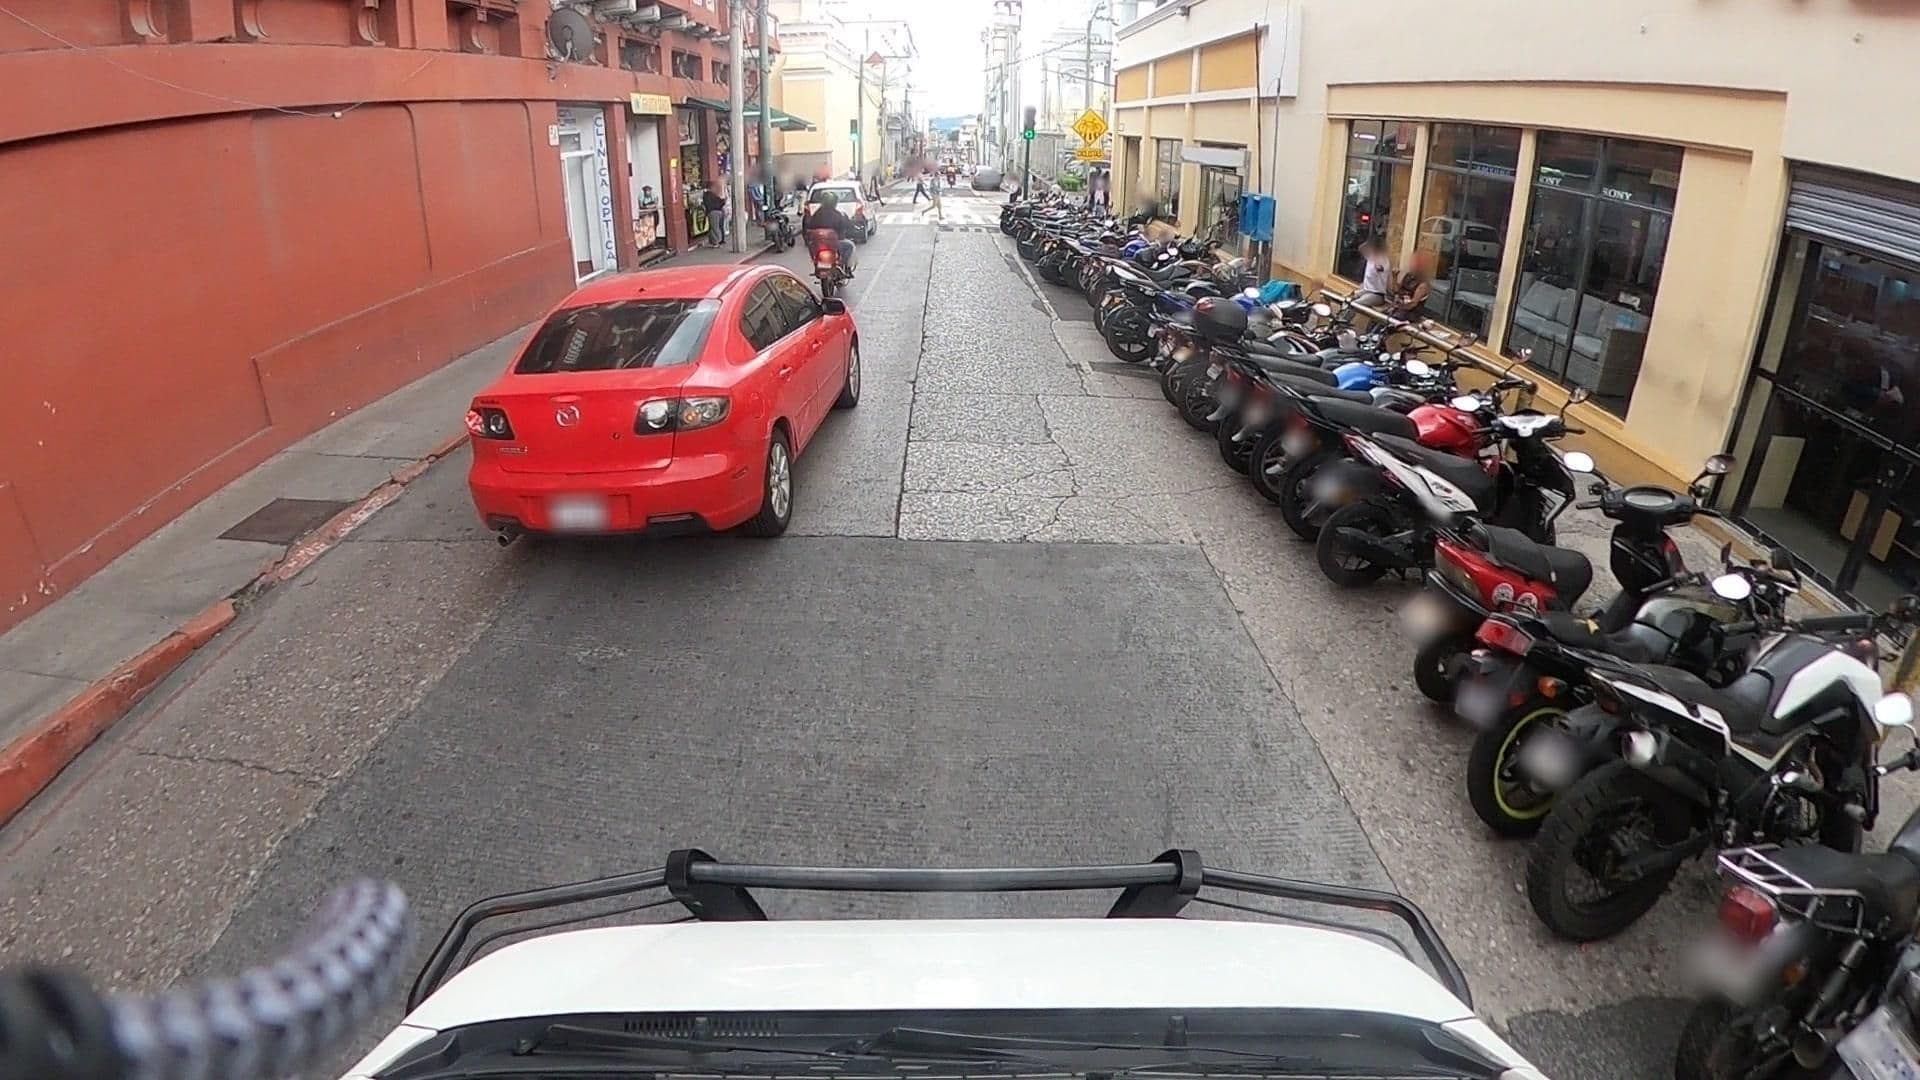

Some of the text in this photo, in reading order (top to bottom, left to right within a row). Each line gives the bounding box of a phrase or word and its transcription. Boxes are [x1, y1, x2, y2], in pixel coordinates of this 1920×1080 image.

[594, 117, 616, 259] CLINICA OPTICA
[1602, 187, 1632, 200] SONY
